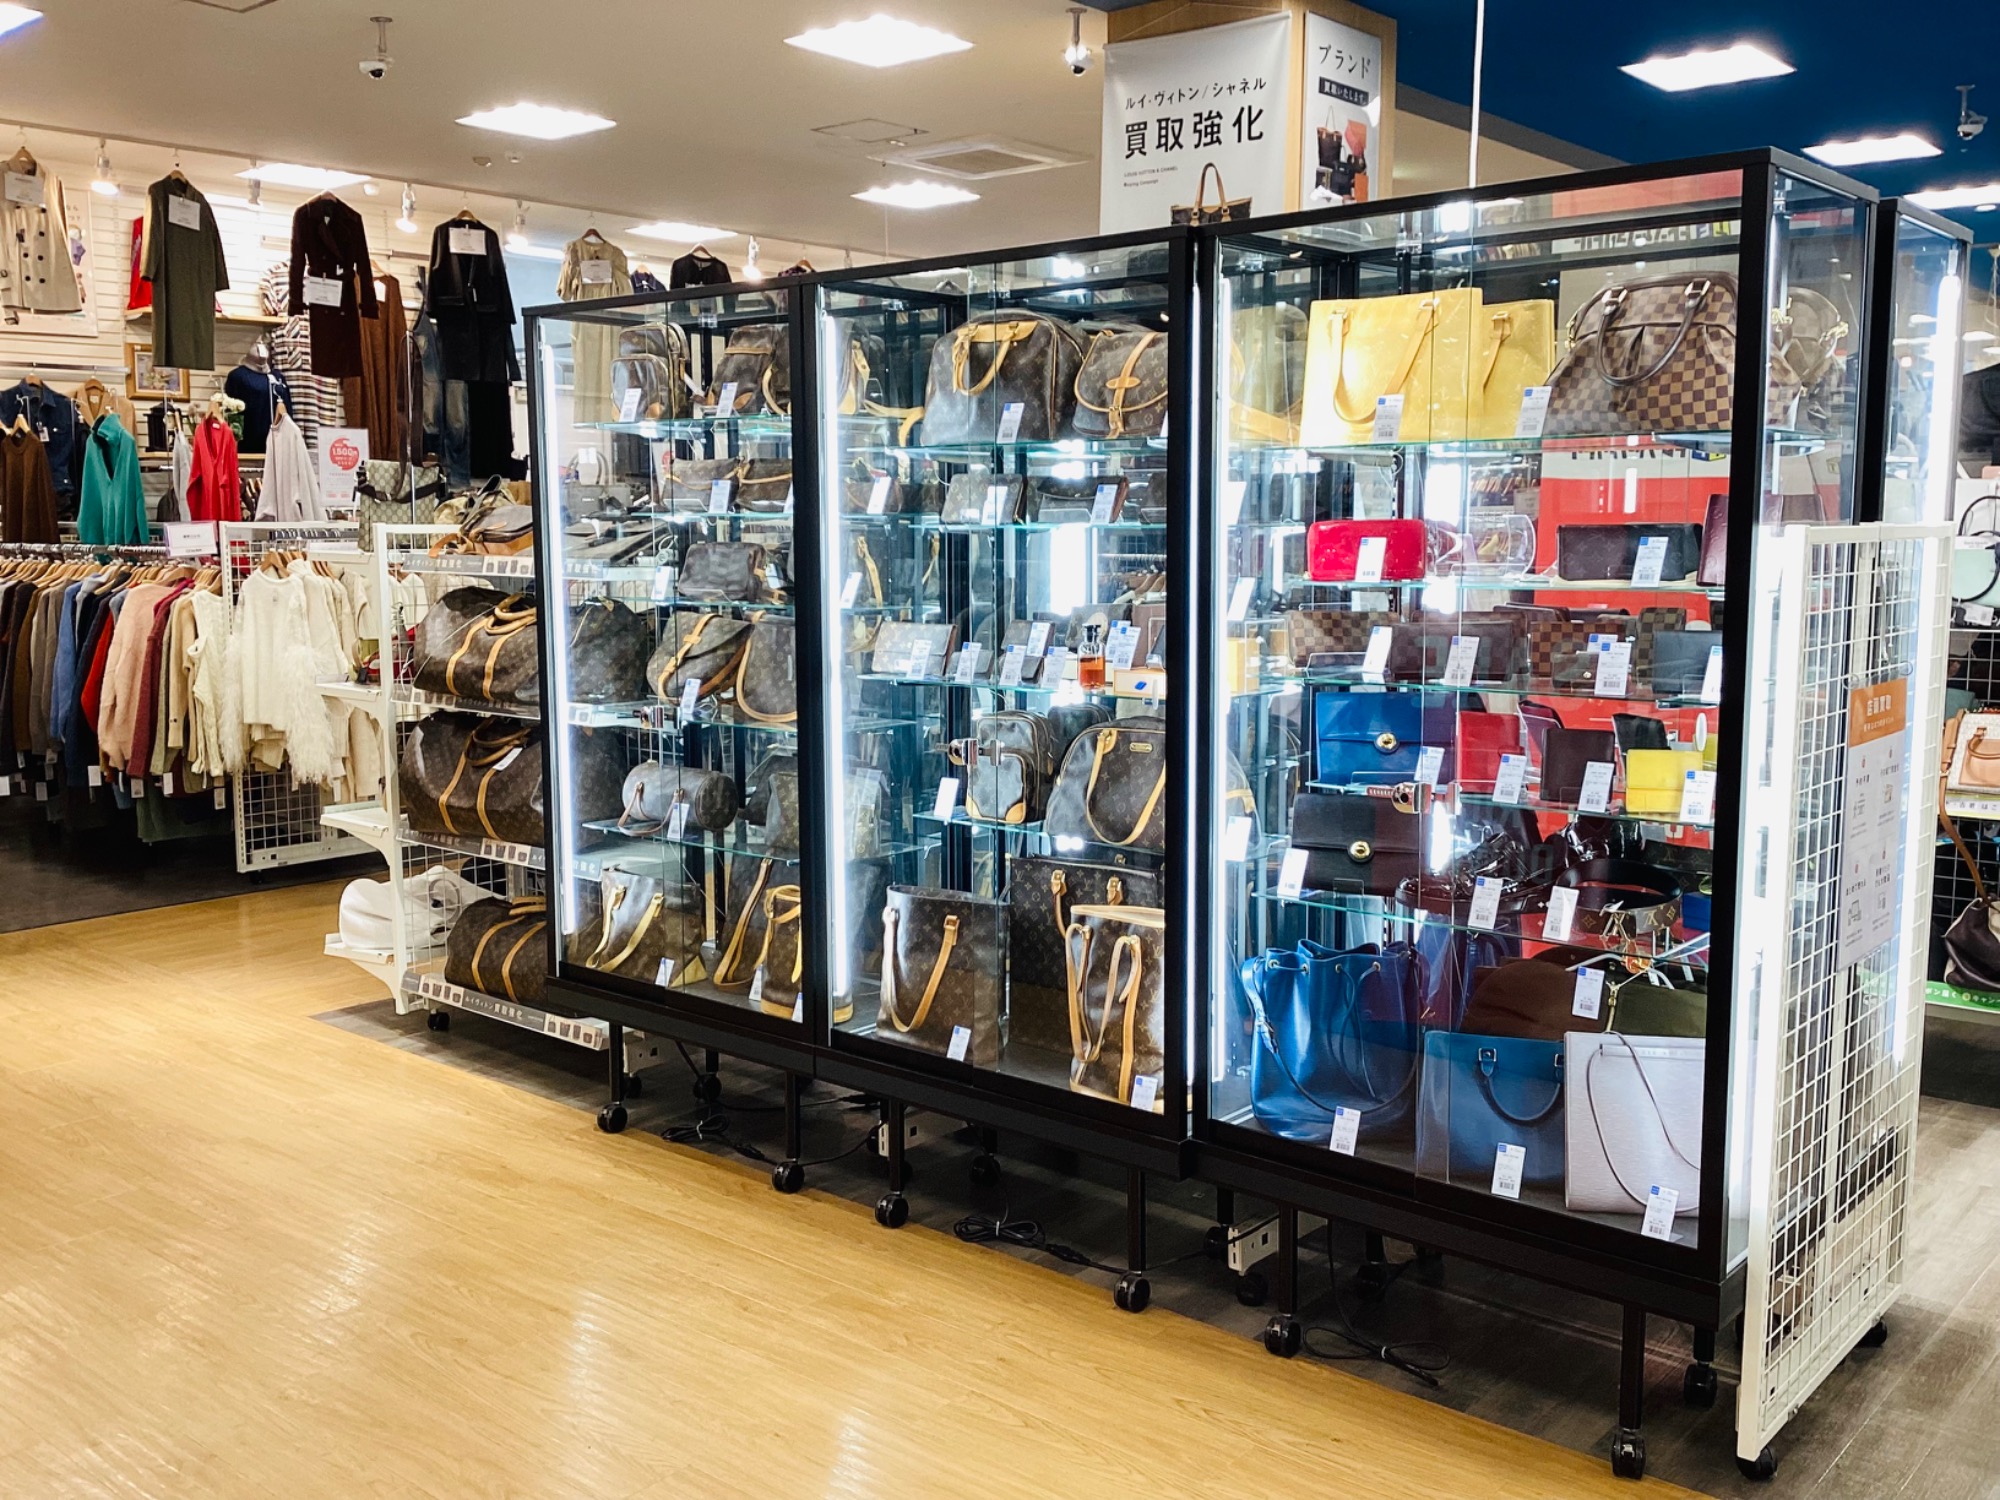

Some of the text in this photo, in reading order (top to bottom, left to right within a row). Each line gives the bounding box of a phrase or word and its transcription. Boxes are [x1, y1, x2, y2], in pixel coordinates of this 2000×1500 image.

[1319, 44, 1371, 79] ブランド
[1125, 105, 1264, 159] 買取強化
